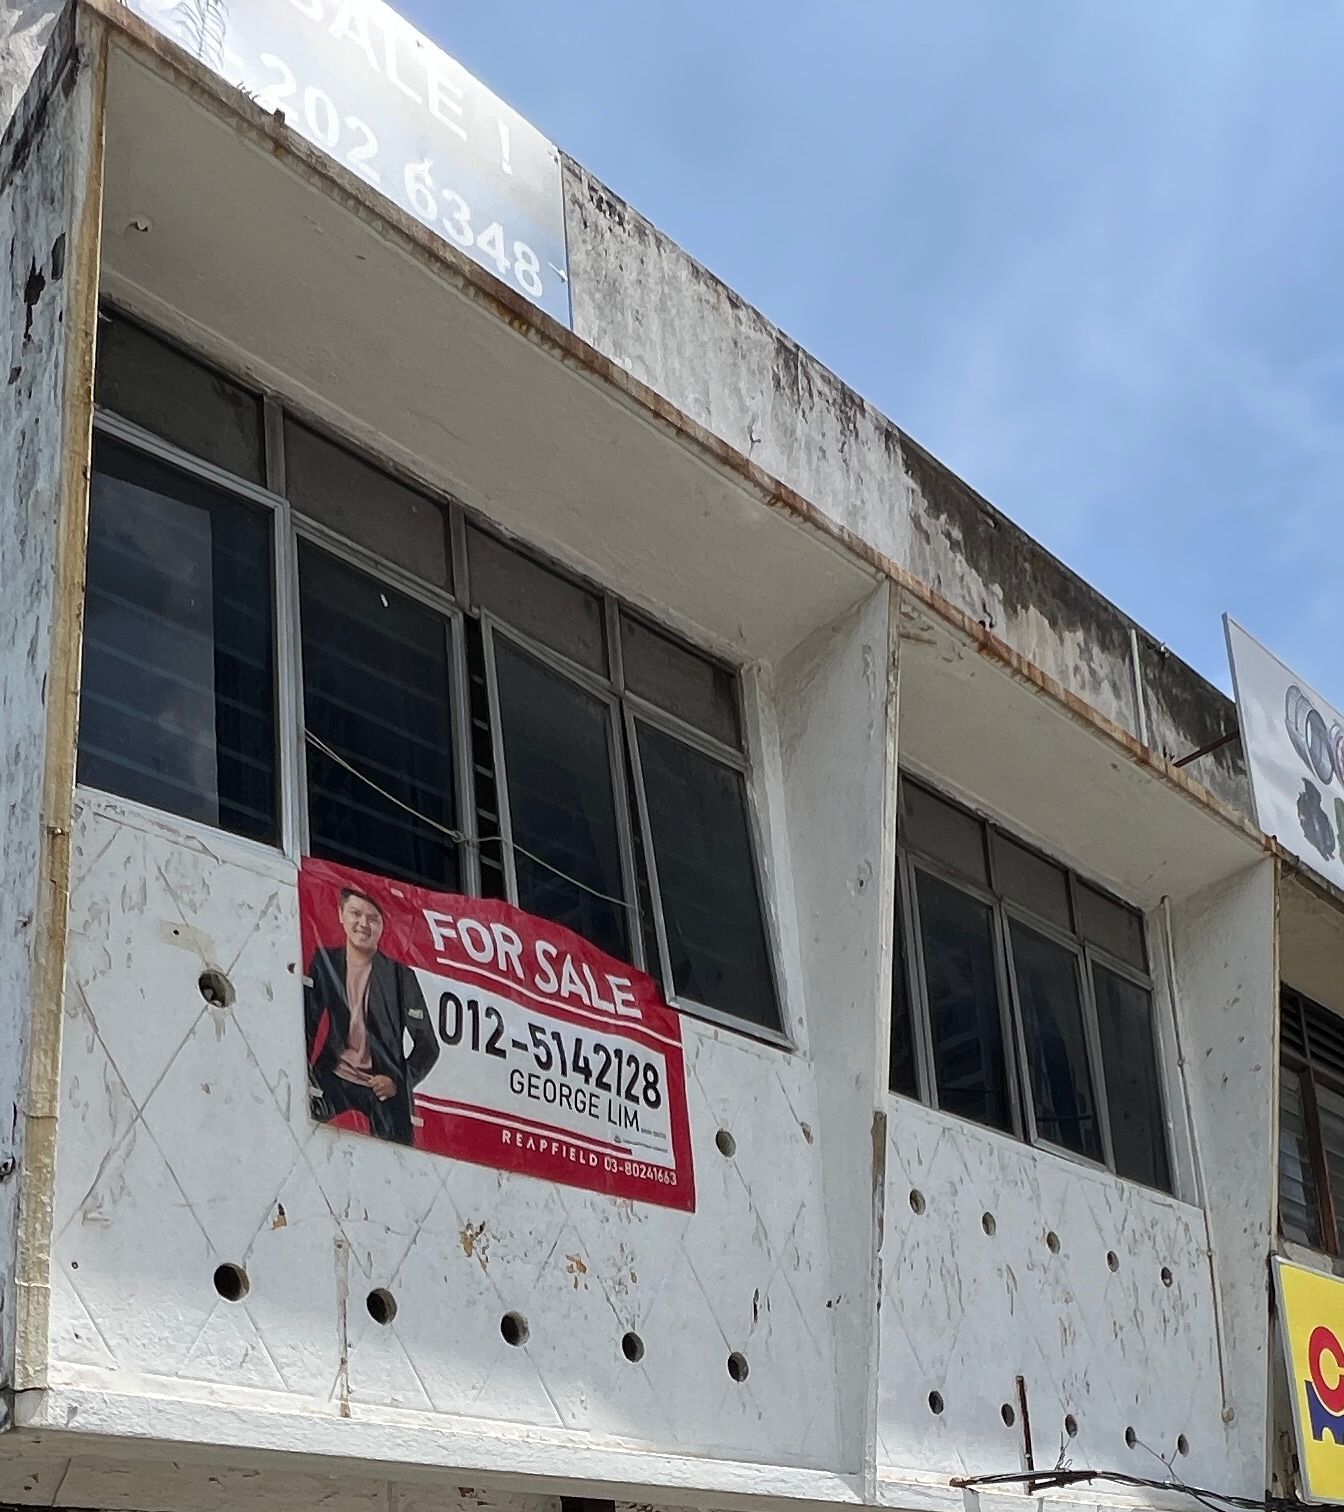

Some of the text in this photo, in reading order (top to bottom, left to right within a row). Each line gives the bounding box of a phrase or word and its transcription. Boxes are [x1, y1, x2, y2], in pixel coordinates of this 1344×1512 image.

[257, 52, 544, 299] 202 6348
[422, 909, 643, 1020] FOR SALE
[438, 991, 662, 1110] 012-5142128
[509, 1068, 640, 1132] GEORGE LIM
[502, 1129, 599, 1168] REAPFIELD
